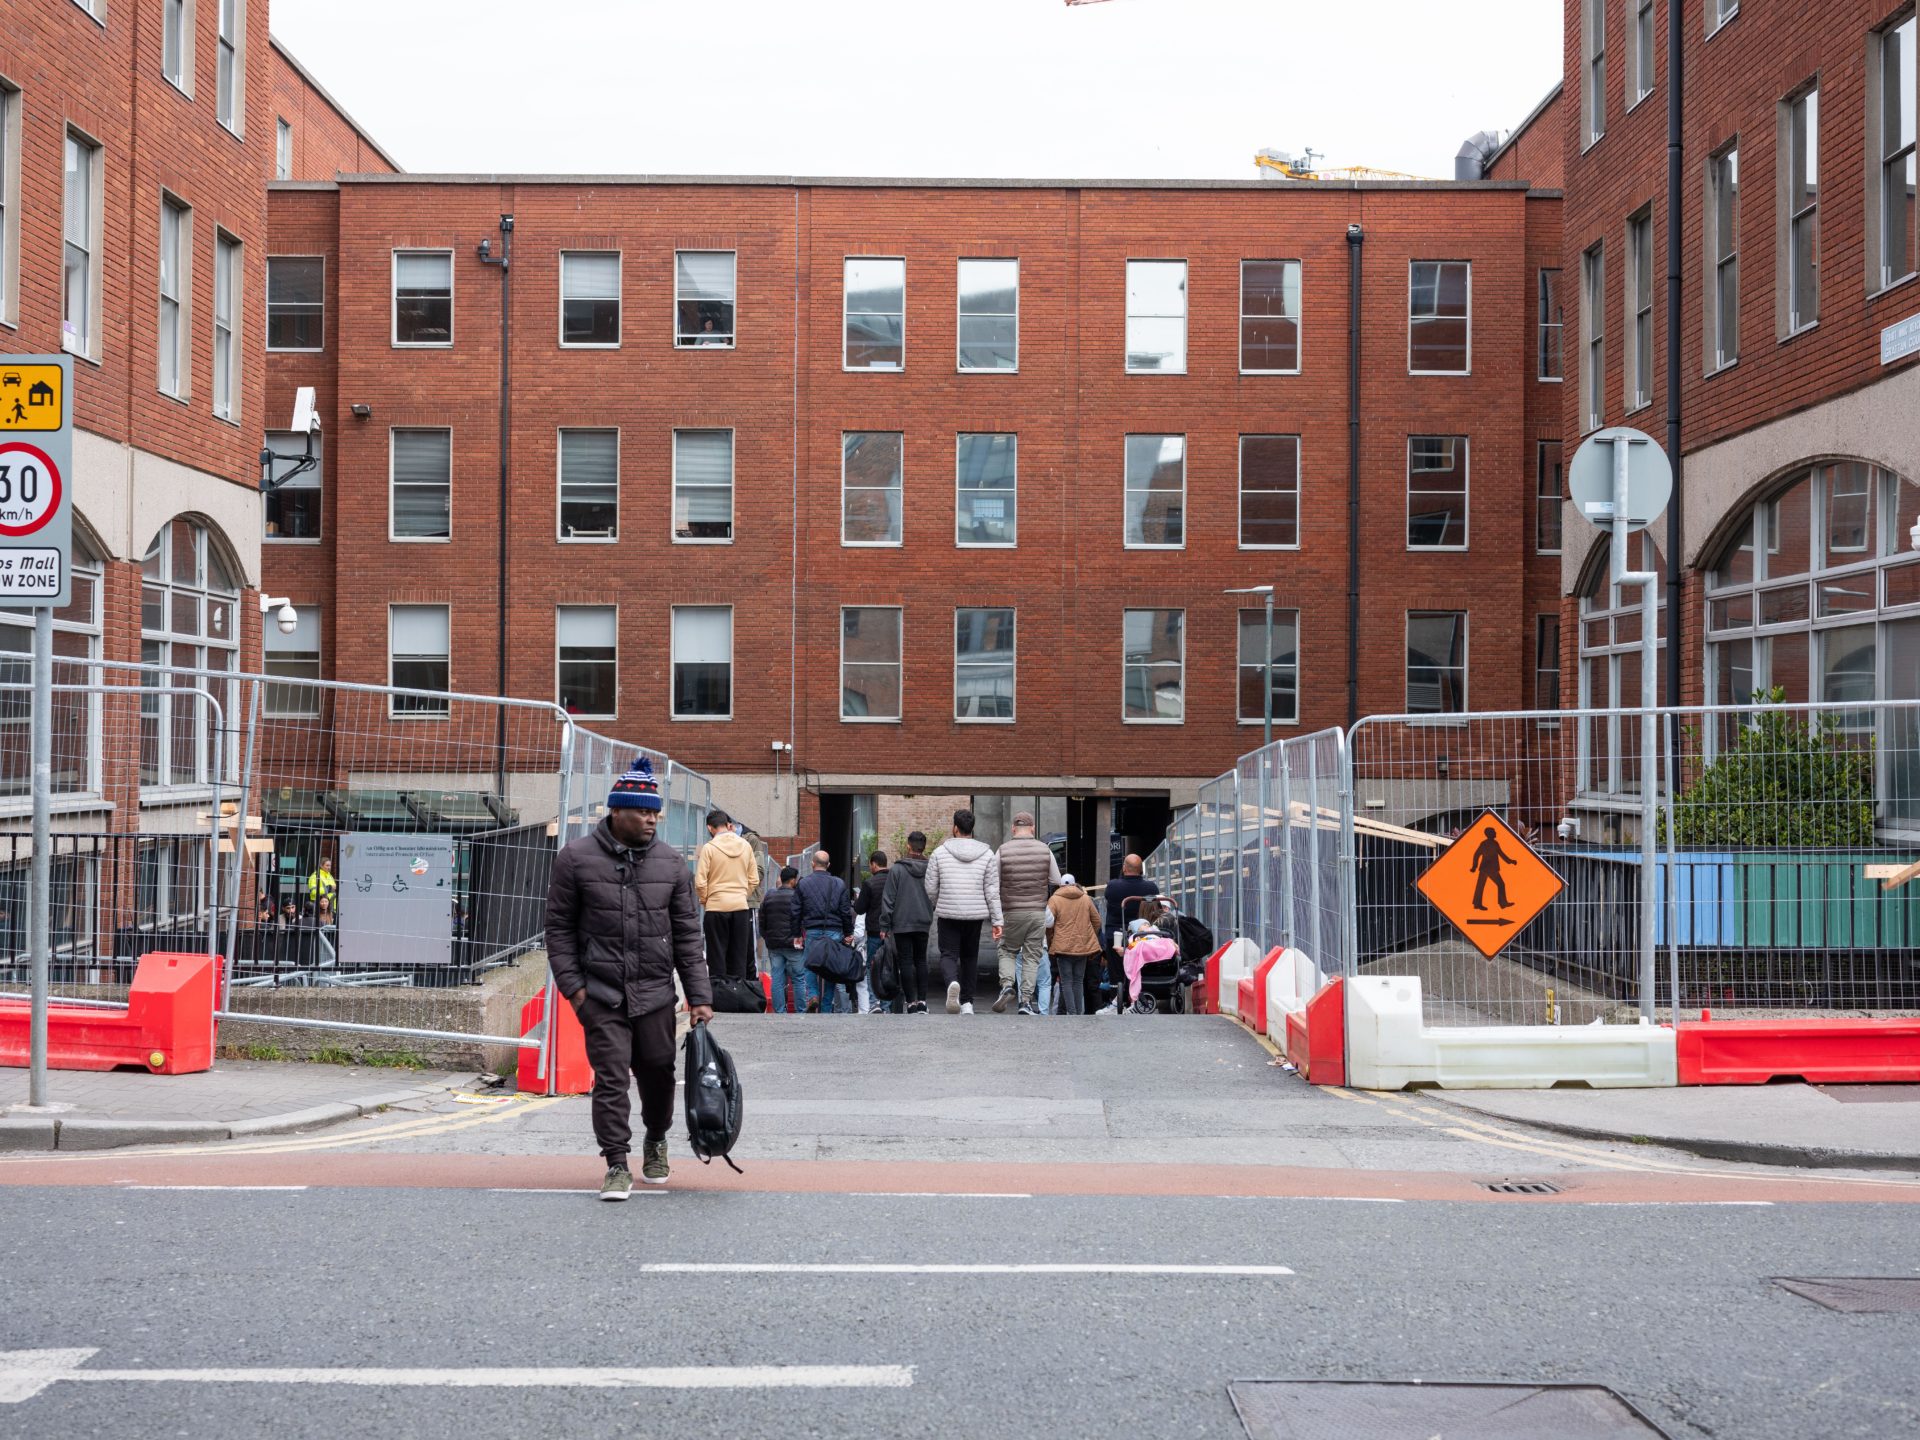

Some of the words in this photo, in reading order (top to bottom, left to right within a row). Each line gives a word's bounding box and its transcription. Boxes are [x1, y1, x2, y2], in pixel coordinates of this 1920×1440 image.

[0, 465, 37, 503] 30
[0, 507, 33, 521] km/h
[20, 556, 55, 570] Mall
[18, 574, 56, 588] ZONE
